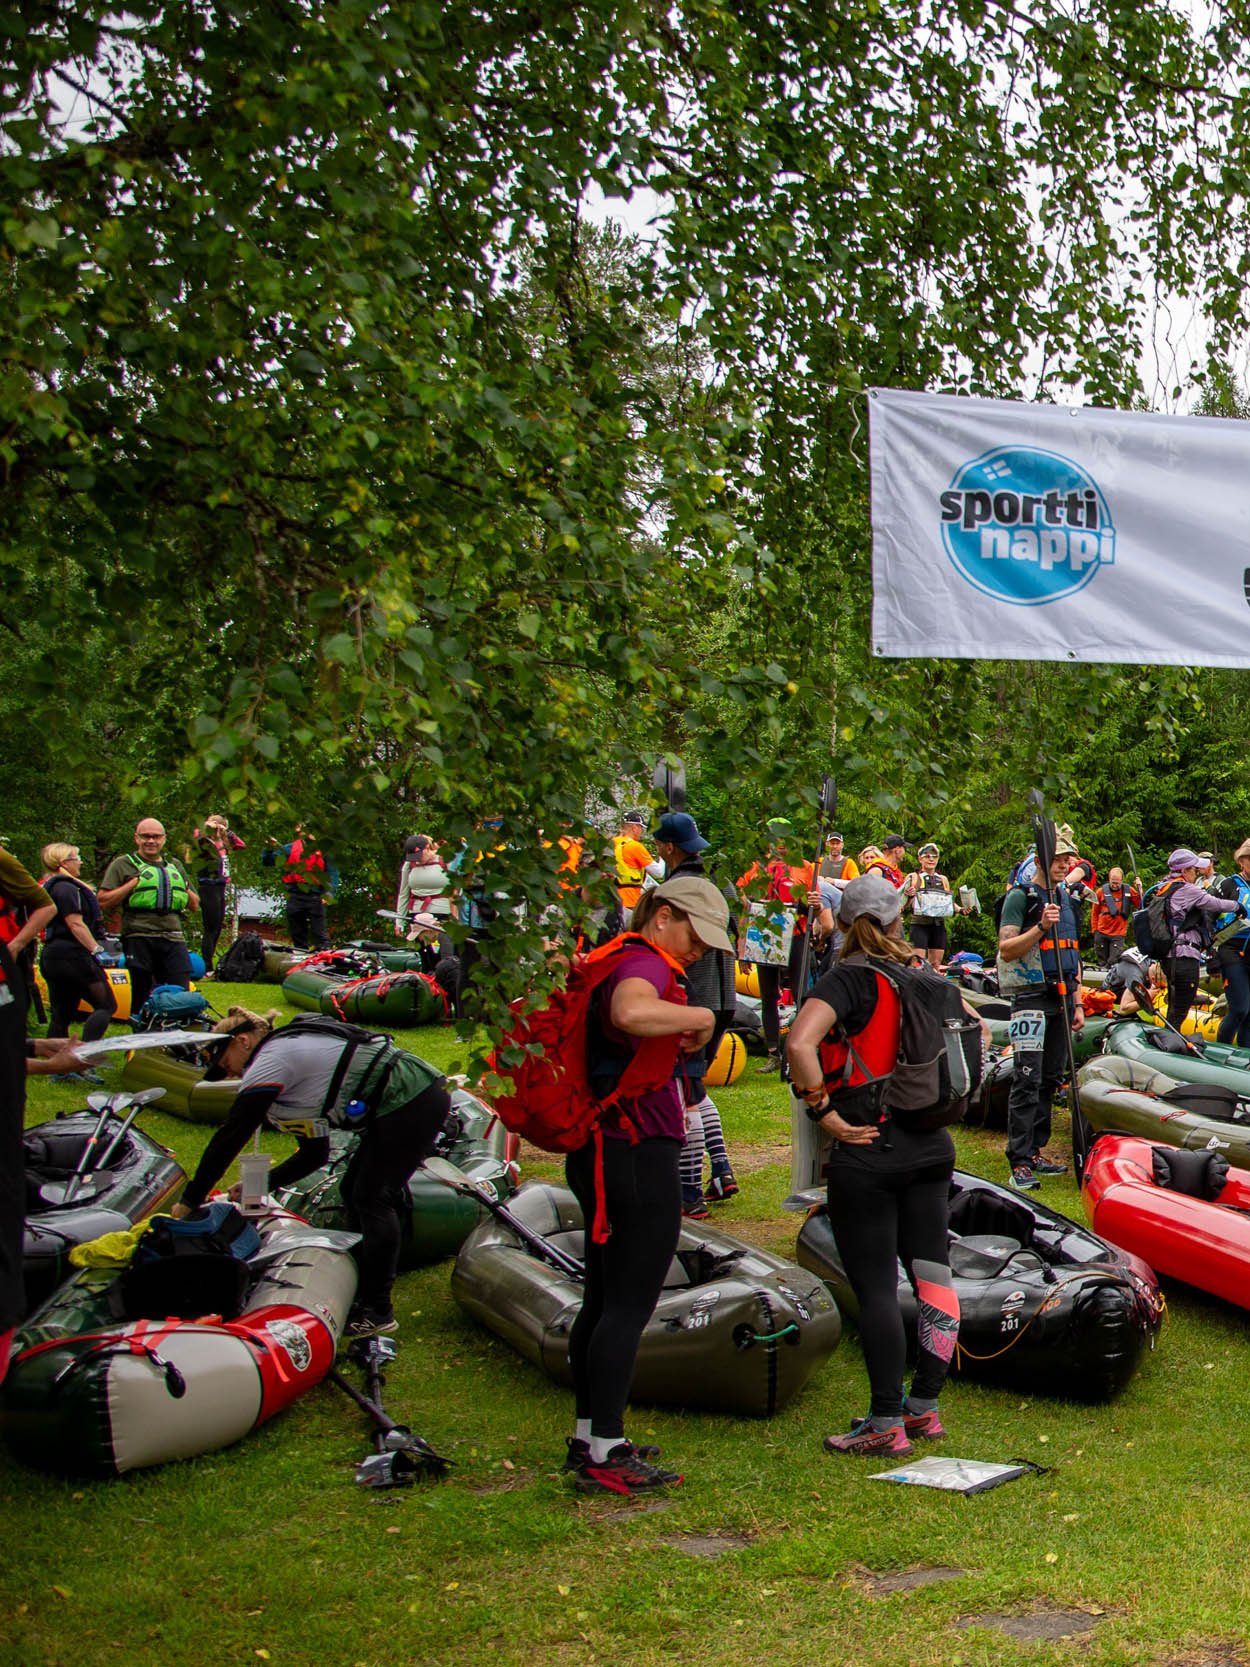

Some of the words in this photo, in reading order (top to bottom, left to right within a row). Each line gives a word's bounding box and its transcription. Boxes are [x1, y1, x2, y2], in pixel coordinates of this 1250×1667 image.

[939, 488, 1098, 530] sportti
[980, 526, 1116, 571] nappi
[1010, 1020, 1042, 1037] 207
[687, 1314, 710, 1329] 201
[1001, 1318, 1019, 1332] 201
